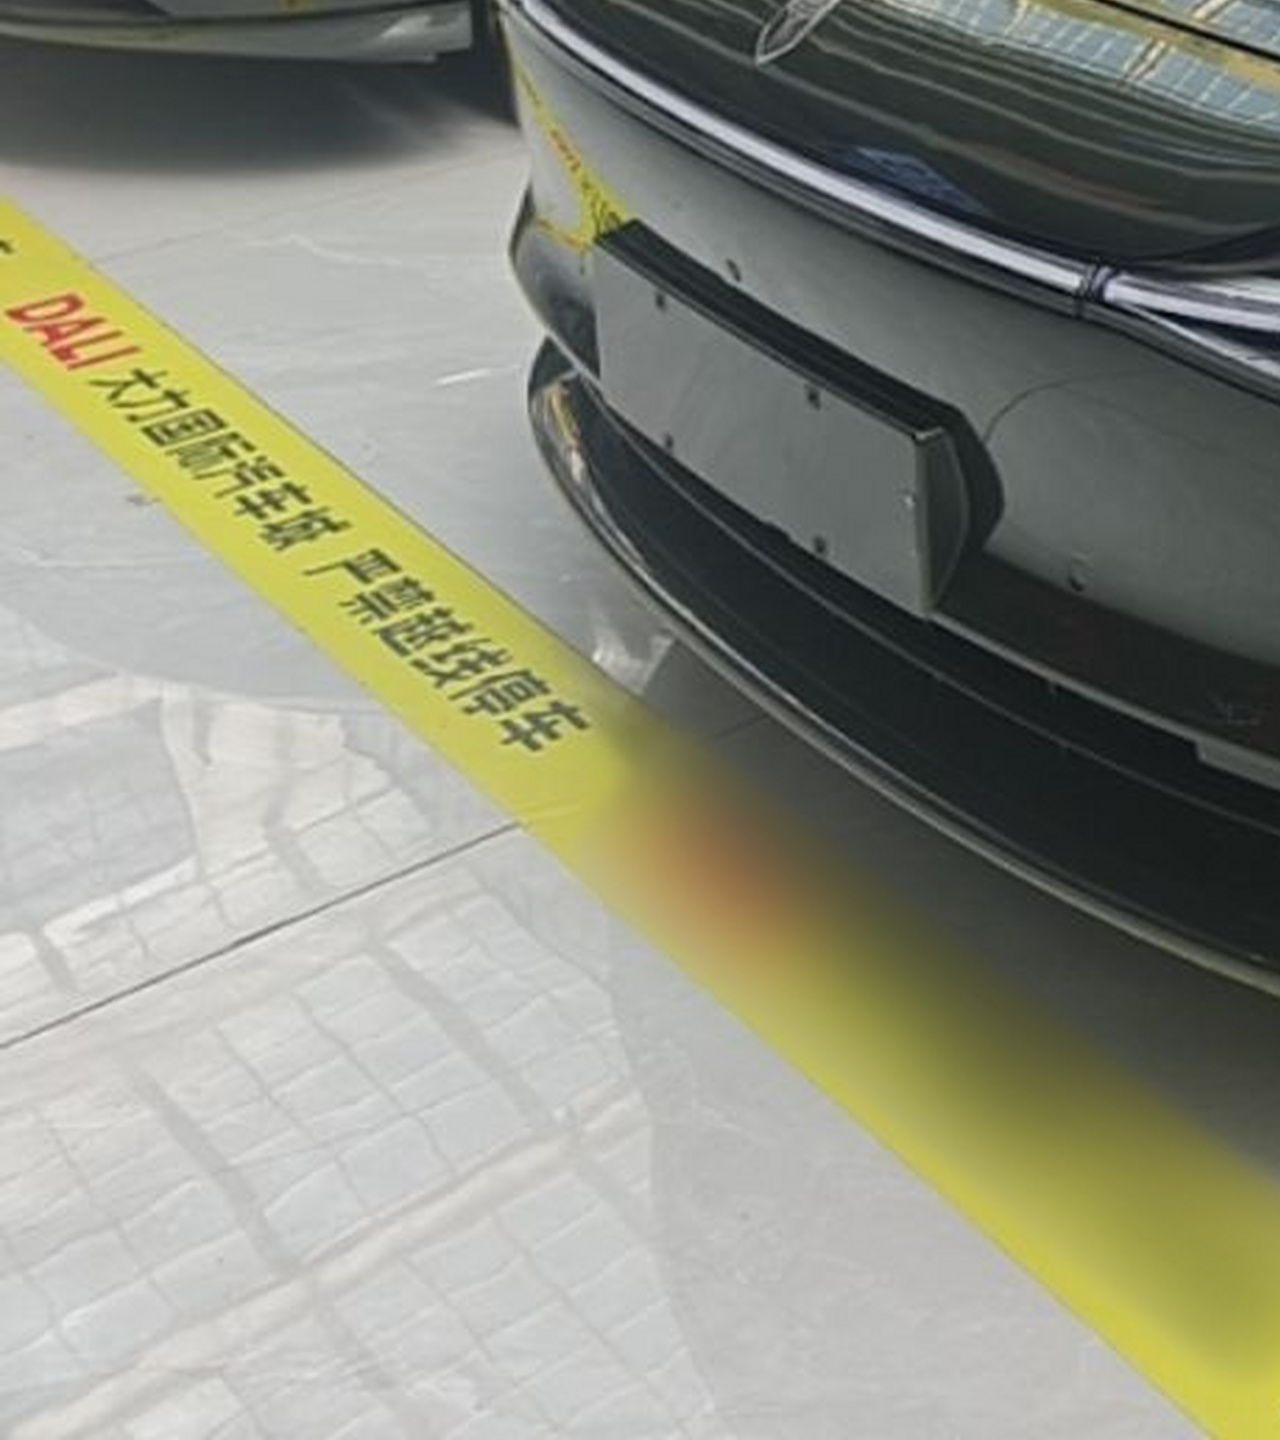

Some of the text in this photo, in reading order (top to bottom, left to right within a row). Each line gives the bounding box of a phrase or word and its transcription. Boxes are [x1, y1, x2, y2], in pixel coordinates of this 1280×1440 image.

[5, 292, 592, 751] DALI 大力国际汽车城 严禁越线停车
